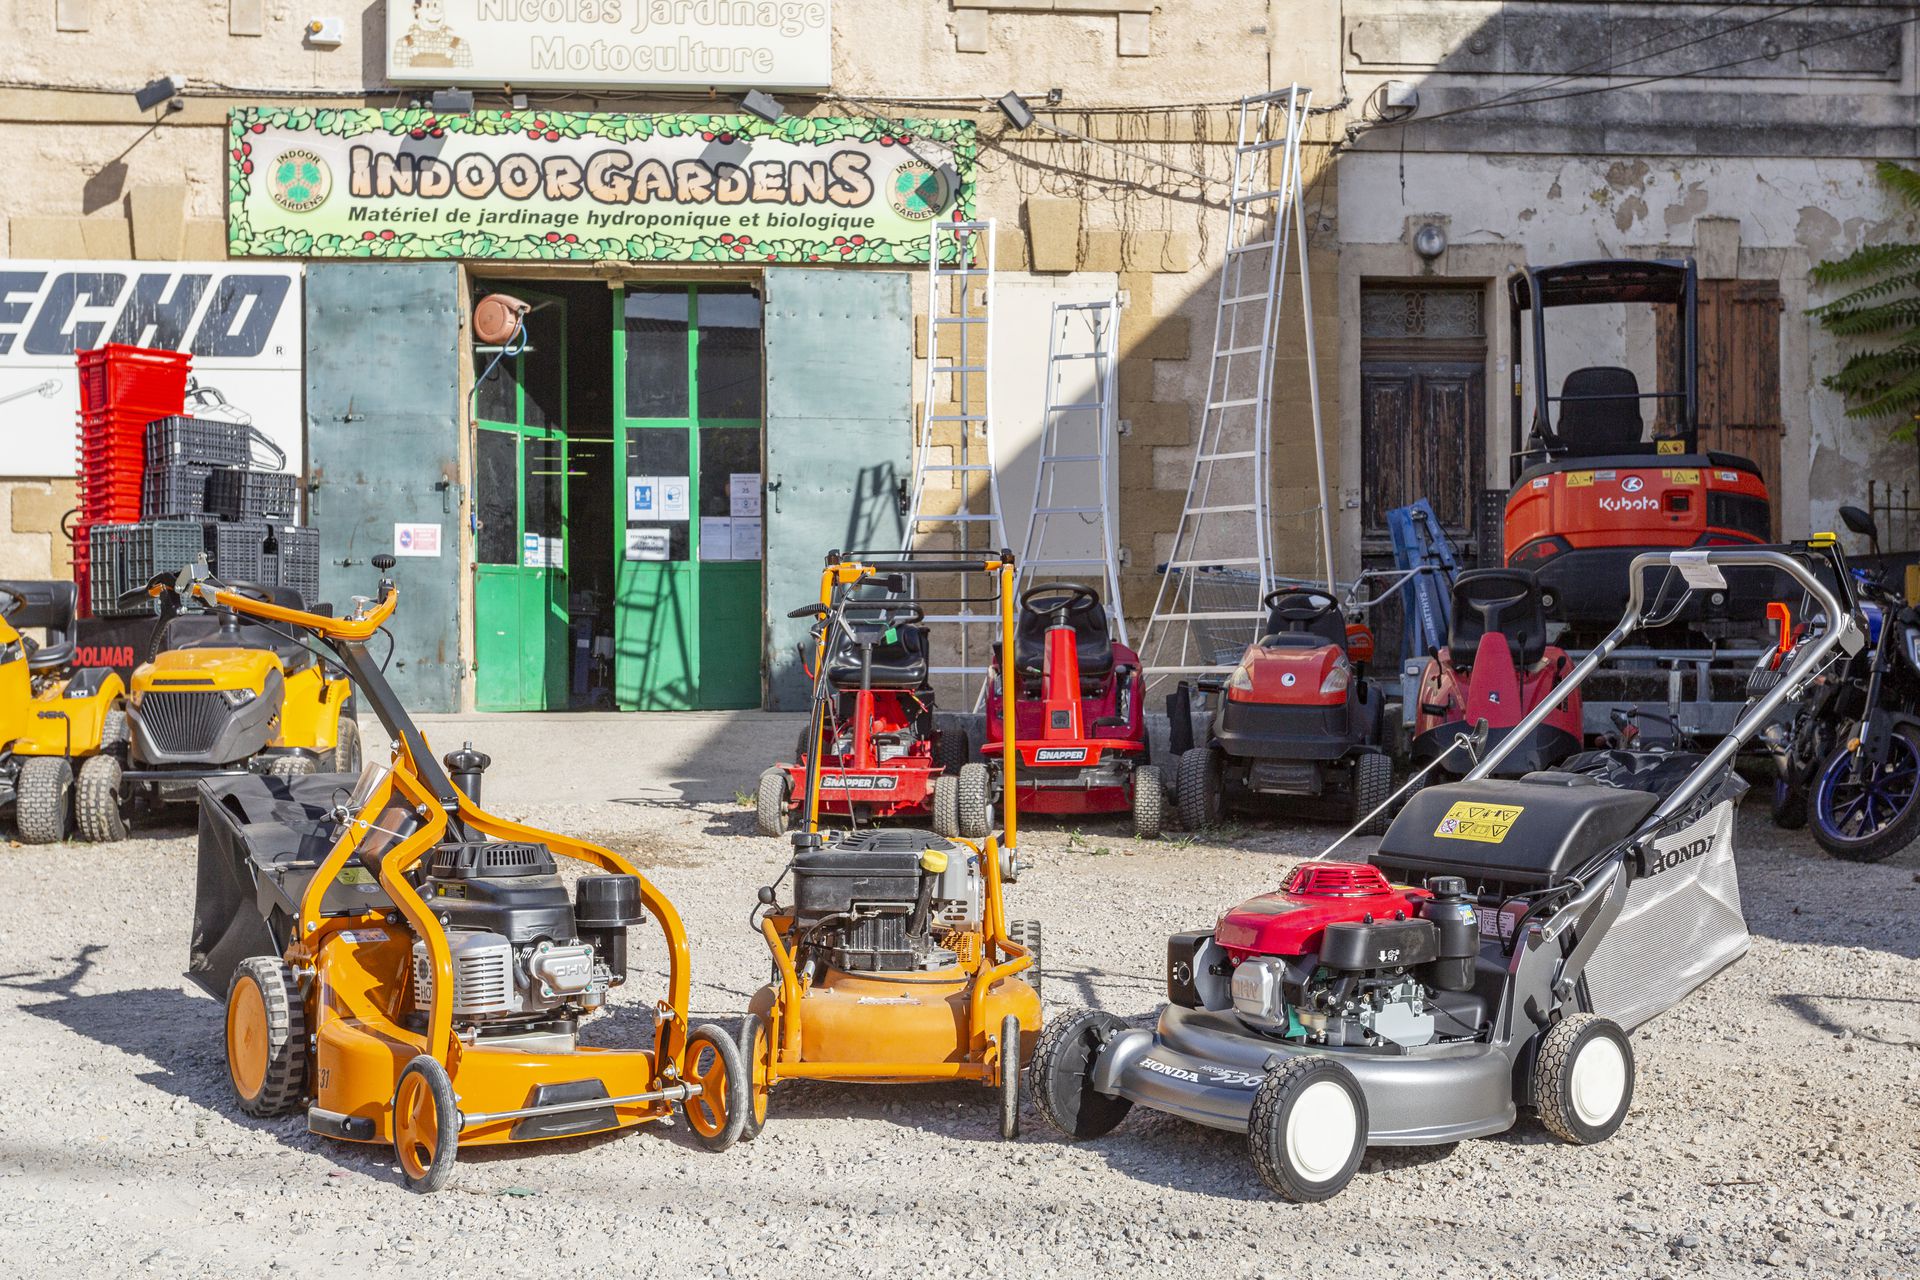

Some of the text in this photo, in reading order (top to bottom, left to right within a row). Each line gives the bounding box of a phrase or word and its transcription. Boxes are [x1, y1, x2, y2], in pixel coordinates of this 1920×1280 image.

[477, 0, 826, 38] Nicolas Jardinage
[530, 35, 774, 73] Motoculture
[276, 149, 321, 165] INDOOR
[895, 159, 938, 175] INDOOR
[274, 192, 324, 210] GARDENS
[348, 206, 875, 231] Matériel de jardinage hydroponique et biologique
[893, 202, 941, 219] GARDENS
[1599, 496, 1659, 511] Kubota
[1420, 592, 1434, 630] MATTHYS
[1039, 751, 1083, 760] SNAPPER
[823, 777, 872, 788] SNAPPER
[553, 962, 591, 977] OHV
[421, 986, 432, 999] HO
[1140, 1058, 1199, 1082] HONDA
